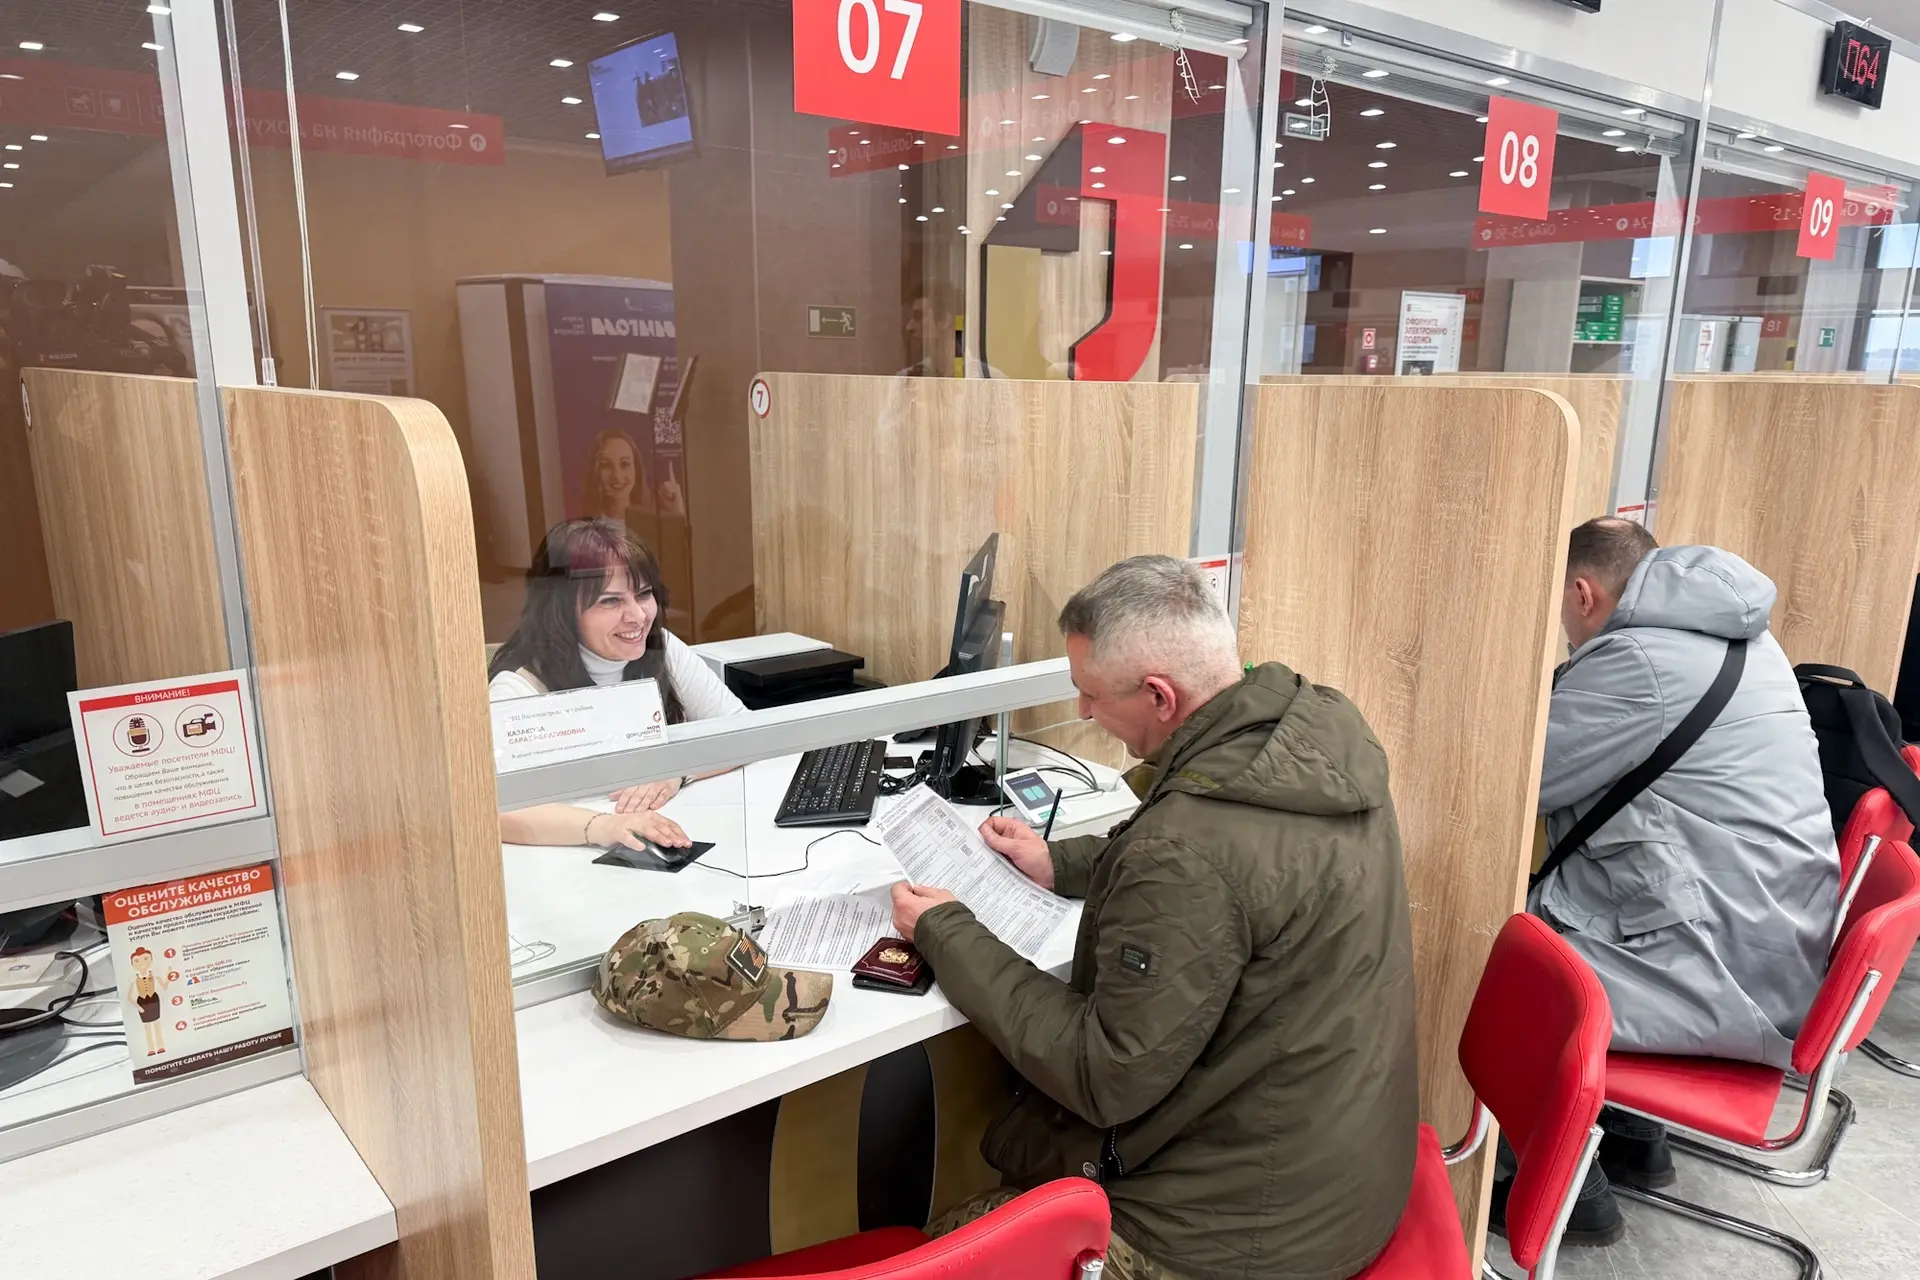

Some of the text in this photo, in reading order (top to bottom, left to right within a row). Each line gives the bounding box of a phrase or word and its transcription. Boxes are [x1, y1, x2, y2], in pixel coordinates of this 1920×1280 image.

[836, 0, 924, 80] 07
[1843, 38, 1881, 89] П64
[1498, 130, 1540, 187] 08
[1810, 196, 1834, 237] 09
[757, 390, 764, 409] 7
[134, 690, 190, 703] ВНИМАНИЕ!
[108, 747, 236, 774] Уважаемые посетители МФЦ!
[142, 793, 197, 808] помещениях
[199, 787, 221, 798] МФЦ
[114, 810, 149, 823] ведется
[189, 794, 243, 809] видеозапись
[114, 870, 261, 909] ОЦЕНИТЕ КАЧЕСТВО
[127, 884, 252, 918] ОБСЛУЖИВАНИЯ
[127, 921, 155, 931] Оценить
[156, 915, 183, 925] качество
[134, 925, 162, 935] качество
[129, 933, 150, 942] услуги
[167, 949, 174, 958] 1
[170, 972, 178, 981] 2
[174, 997, 182, 1006] 3
[177, 1021, 187, 1031] 4
[145, 1032, 282, 1075] ПОМОГИТЕ СДЕЛАТЬ НАШУ РАБОТУ ЛУЧШЕ
